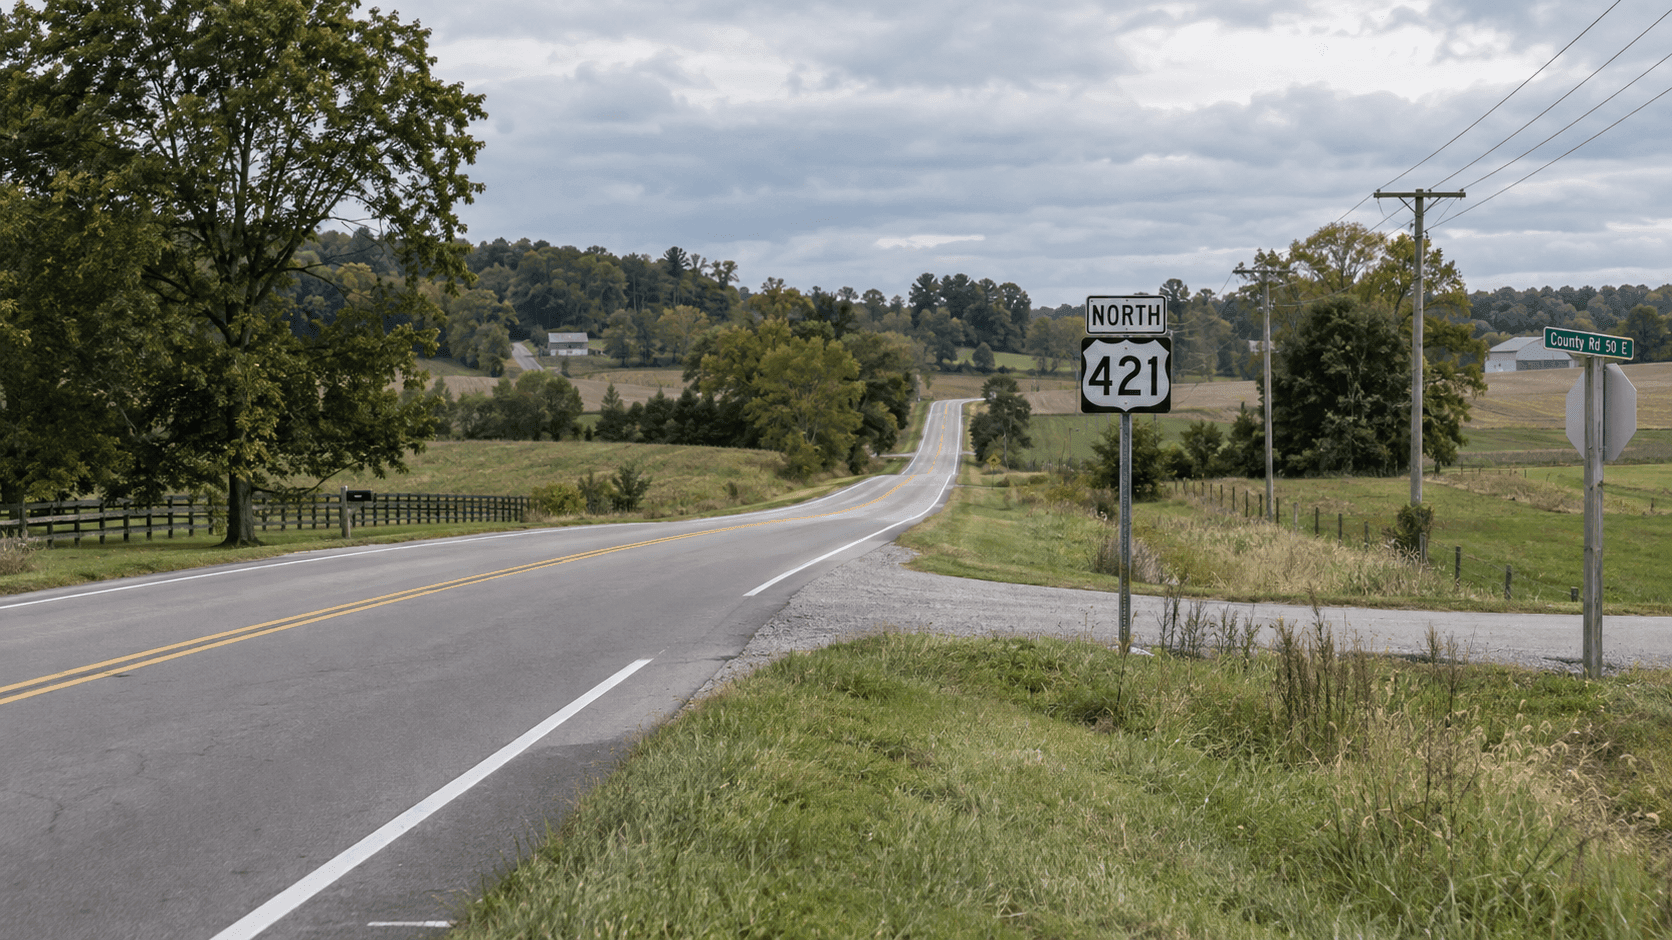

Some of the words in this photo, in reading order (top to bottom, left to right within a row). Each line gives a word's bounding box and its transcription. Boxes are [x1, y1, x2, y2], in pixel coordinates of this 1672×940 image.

[1092, 304, 1160, 326] NORTH
[1550, 331, 1585, 351] County
[1588, 336, 1601, 351] Rd
[1605, 339, 1617, 353] 50
[1621, 341, 1628, 355] E
[1088, 355, 1158, 396] 421
